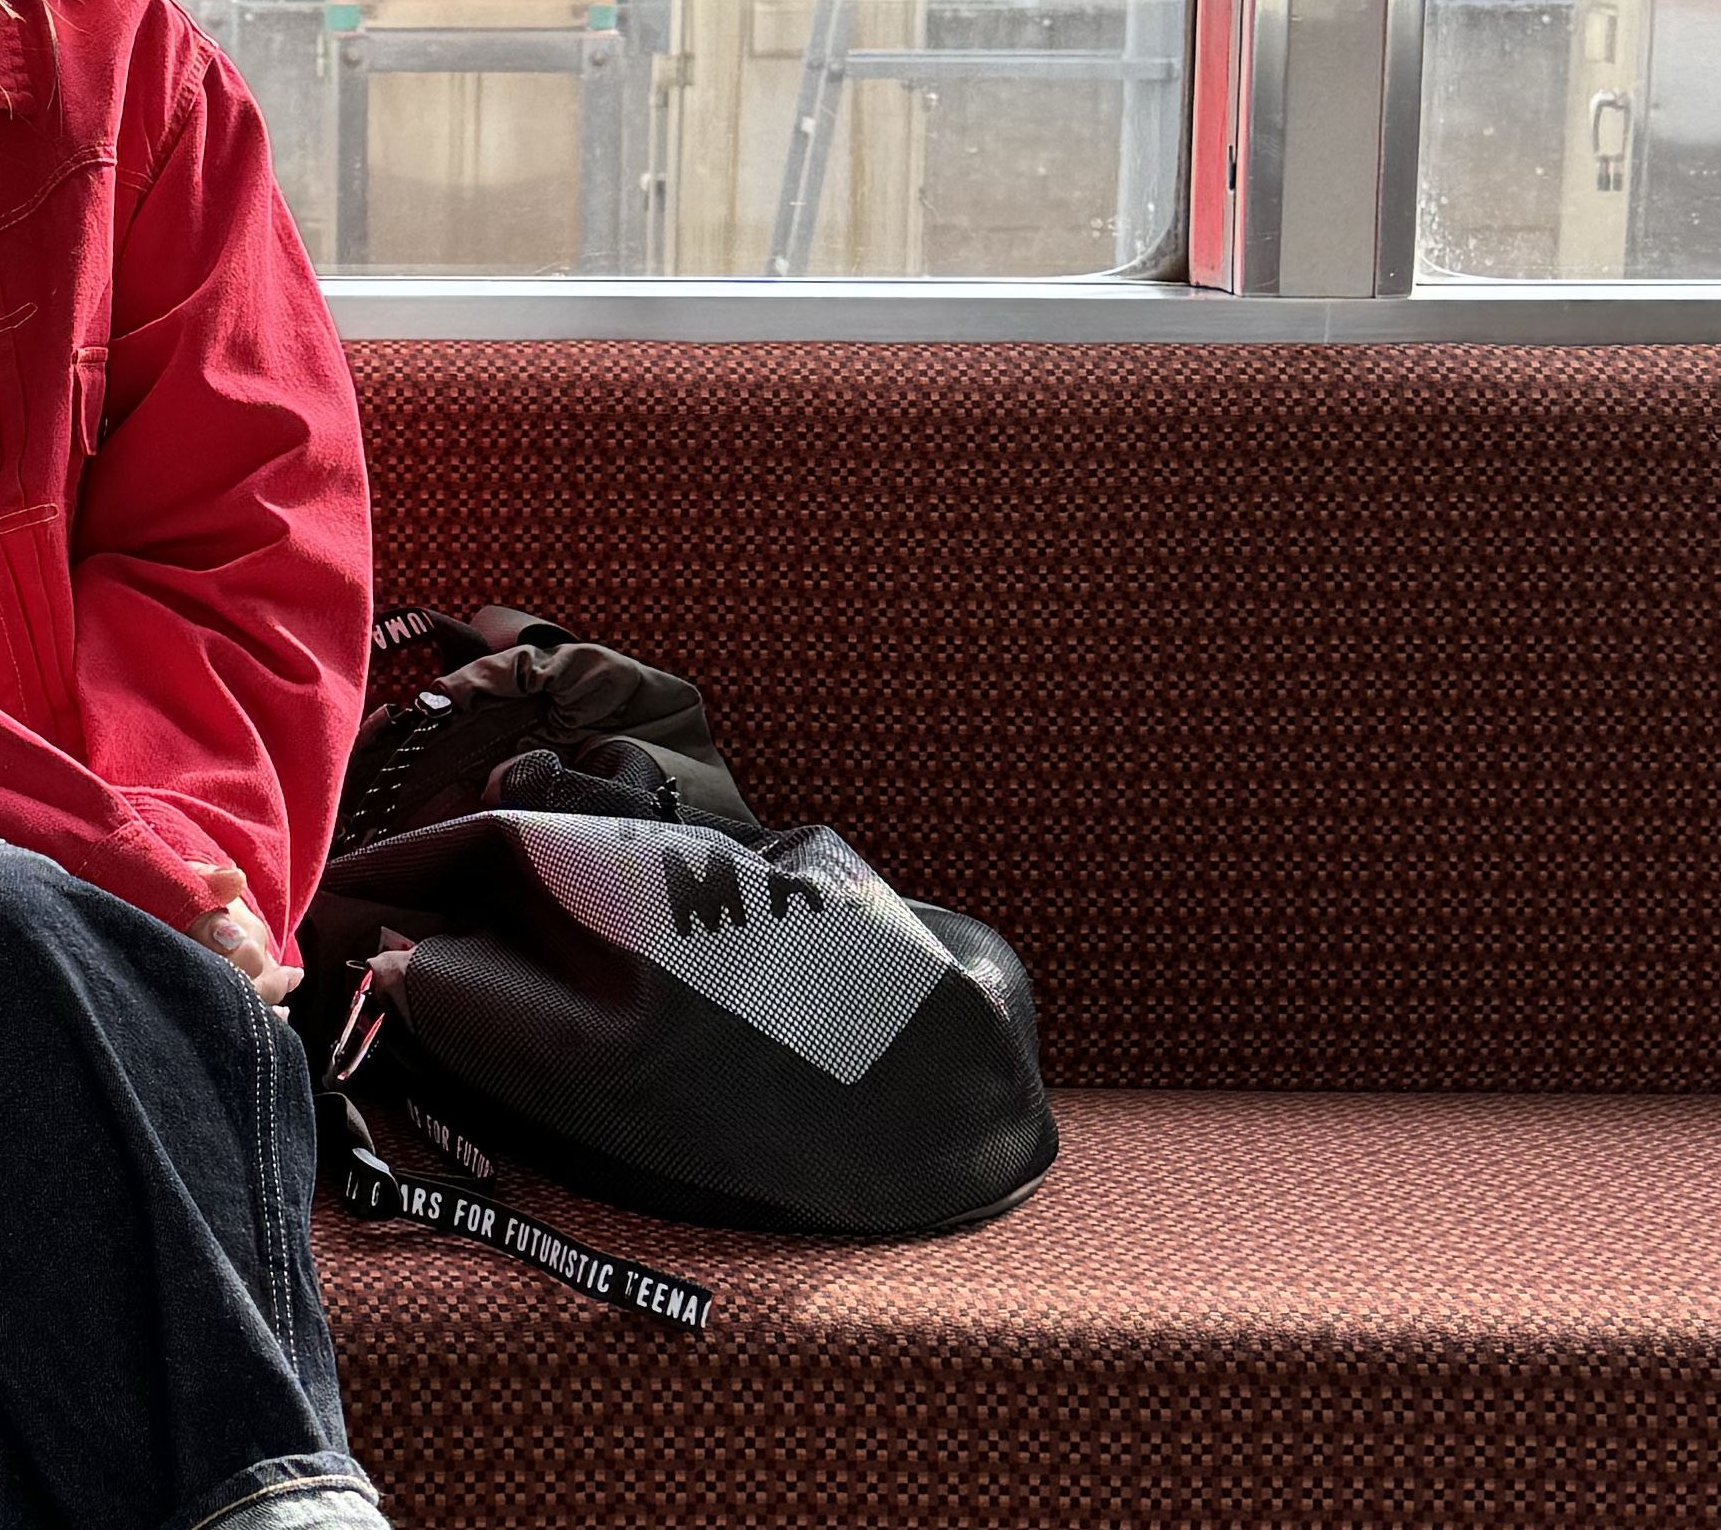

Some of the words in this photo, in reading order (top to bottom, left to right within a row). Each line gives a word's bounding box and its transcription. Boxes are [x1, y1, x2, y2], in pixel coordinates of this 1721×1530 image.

[372, 610, 435, 650] UMA
[453, 1198, 496, 1239] FOR
[504, 1217, 614, 1294] FUTURISTIC
